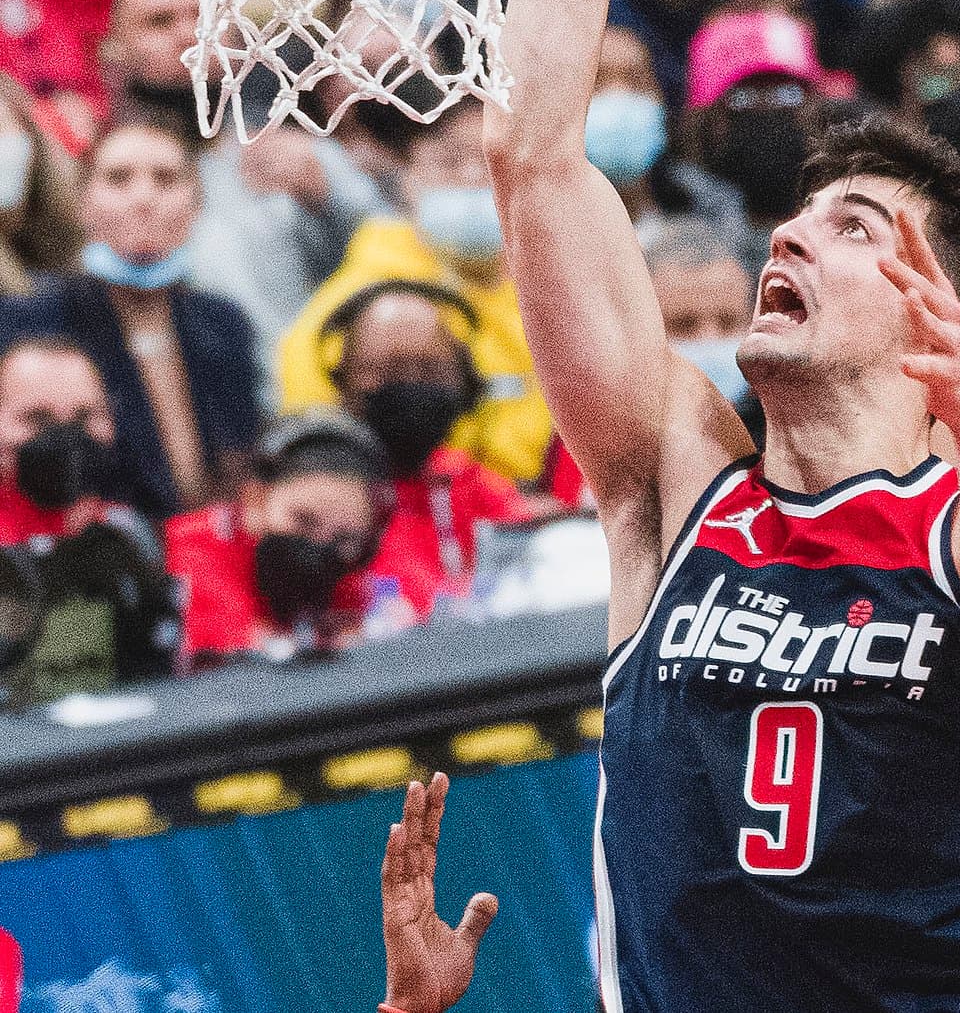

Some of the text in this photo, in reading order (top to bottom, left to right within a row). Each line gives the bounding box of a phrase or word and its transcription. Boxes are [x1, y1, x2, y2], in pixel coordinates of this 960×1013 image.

[658, 573, 945, 681] district
[738, 586, 790, 615] THE
[658, 664, 925, 701] OF COLUMA
[737, 701, 824, 876] 9
